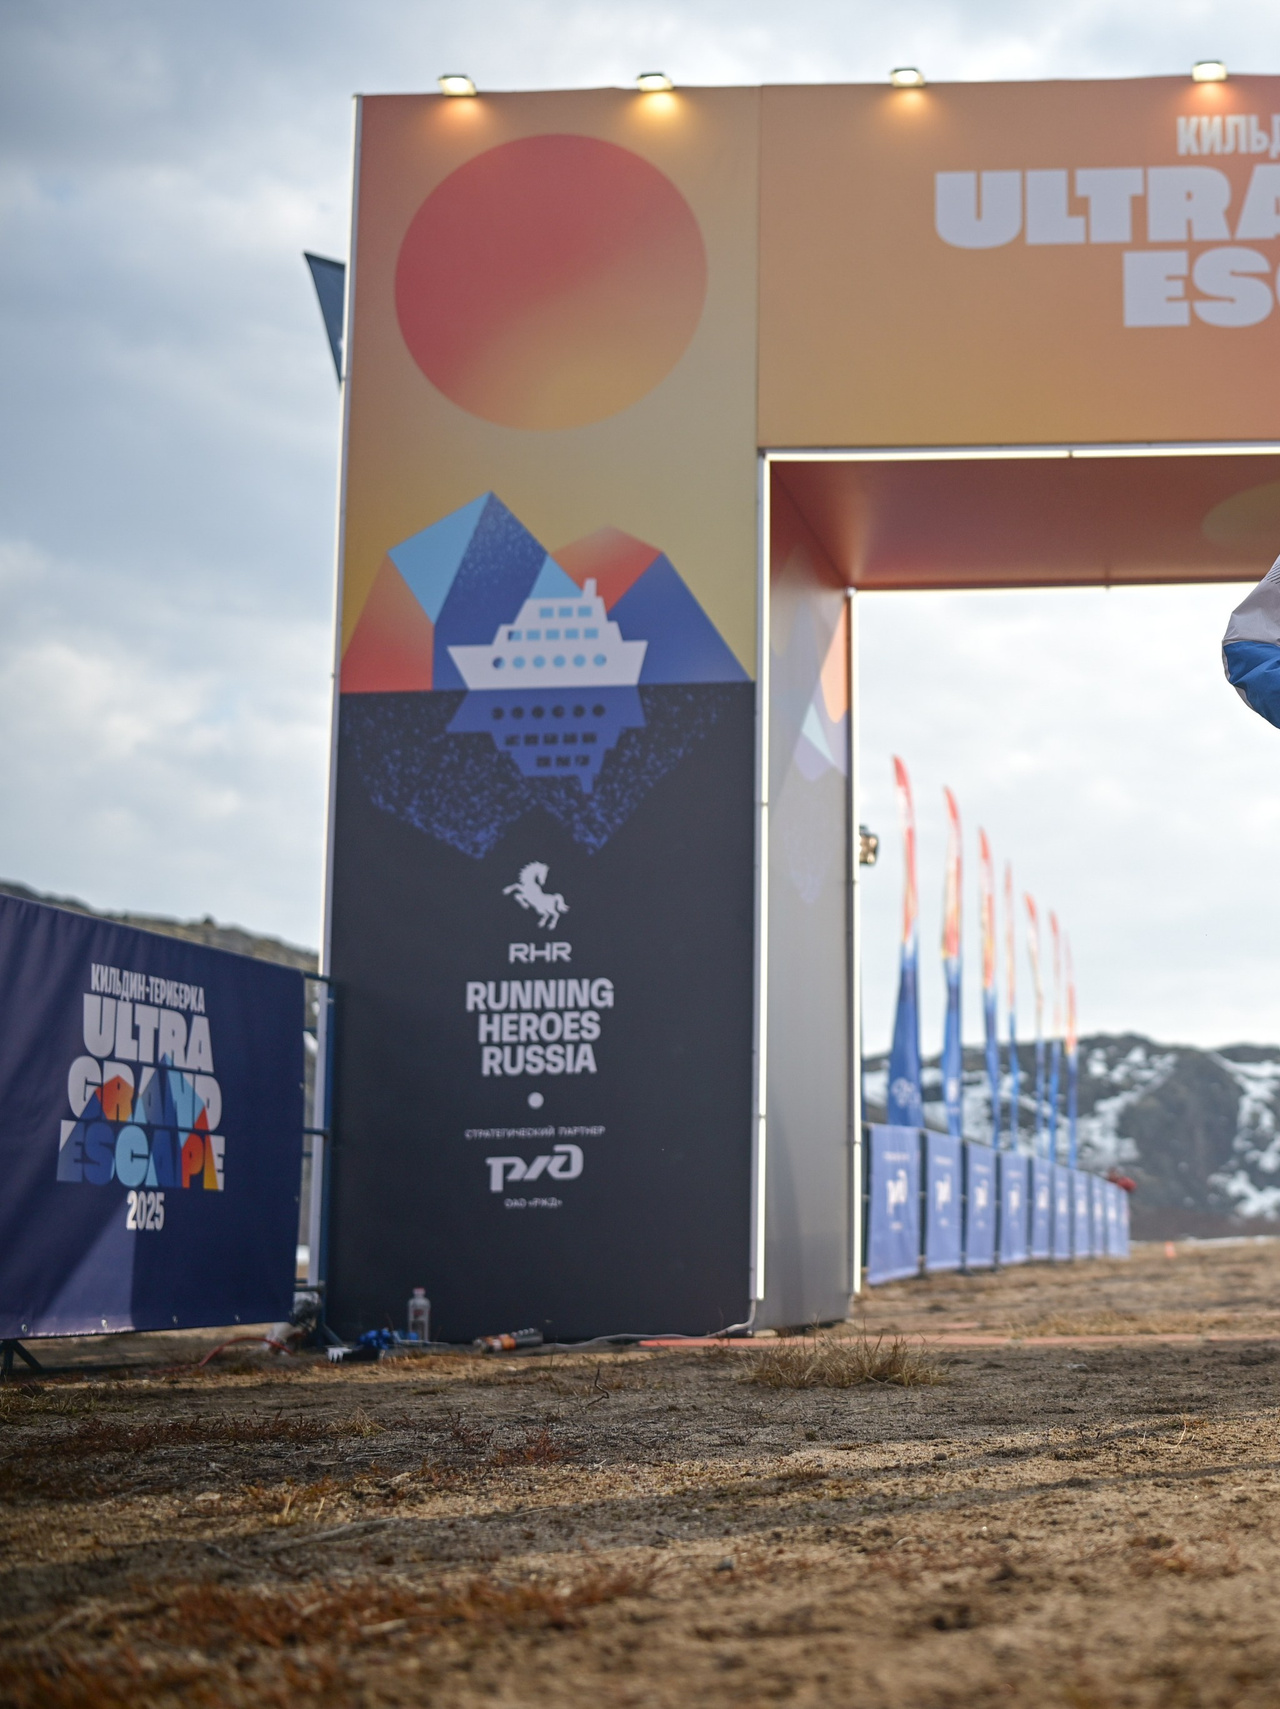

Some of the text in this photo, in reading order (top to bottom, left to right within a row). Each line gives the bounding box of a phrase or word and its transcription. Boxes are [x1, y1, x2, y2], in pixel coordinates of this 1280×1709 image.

[508, 941, 572, 963] RHR
[91, 963, 206, 1014] КИЛЬДИН-ТЕРИБЕРКА
[465, 977, 615, 1012] RUNNING
[83, 993, 215, 1075] ULTRA
[478, 1010, 602, 1044] HEROES
[481, 1043, 598, 1077] RUSSIA
[67, 1055, 222, 1132] GRAND
[56, 1119, 226, 1192] ESCAPE
[126, 1190, 165, 1231] 2025
